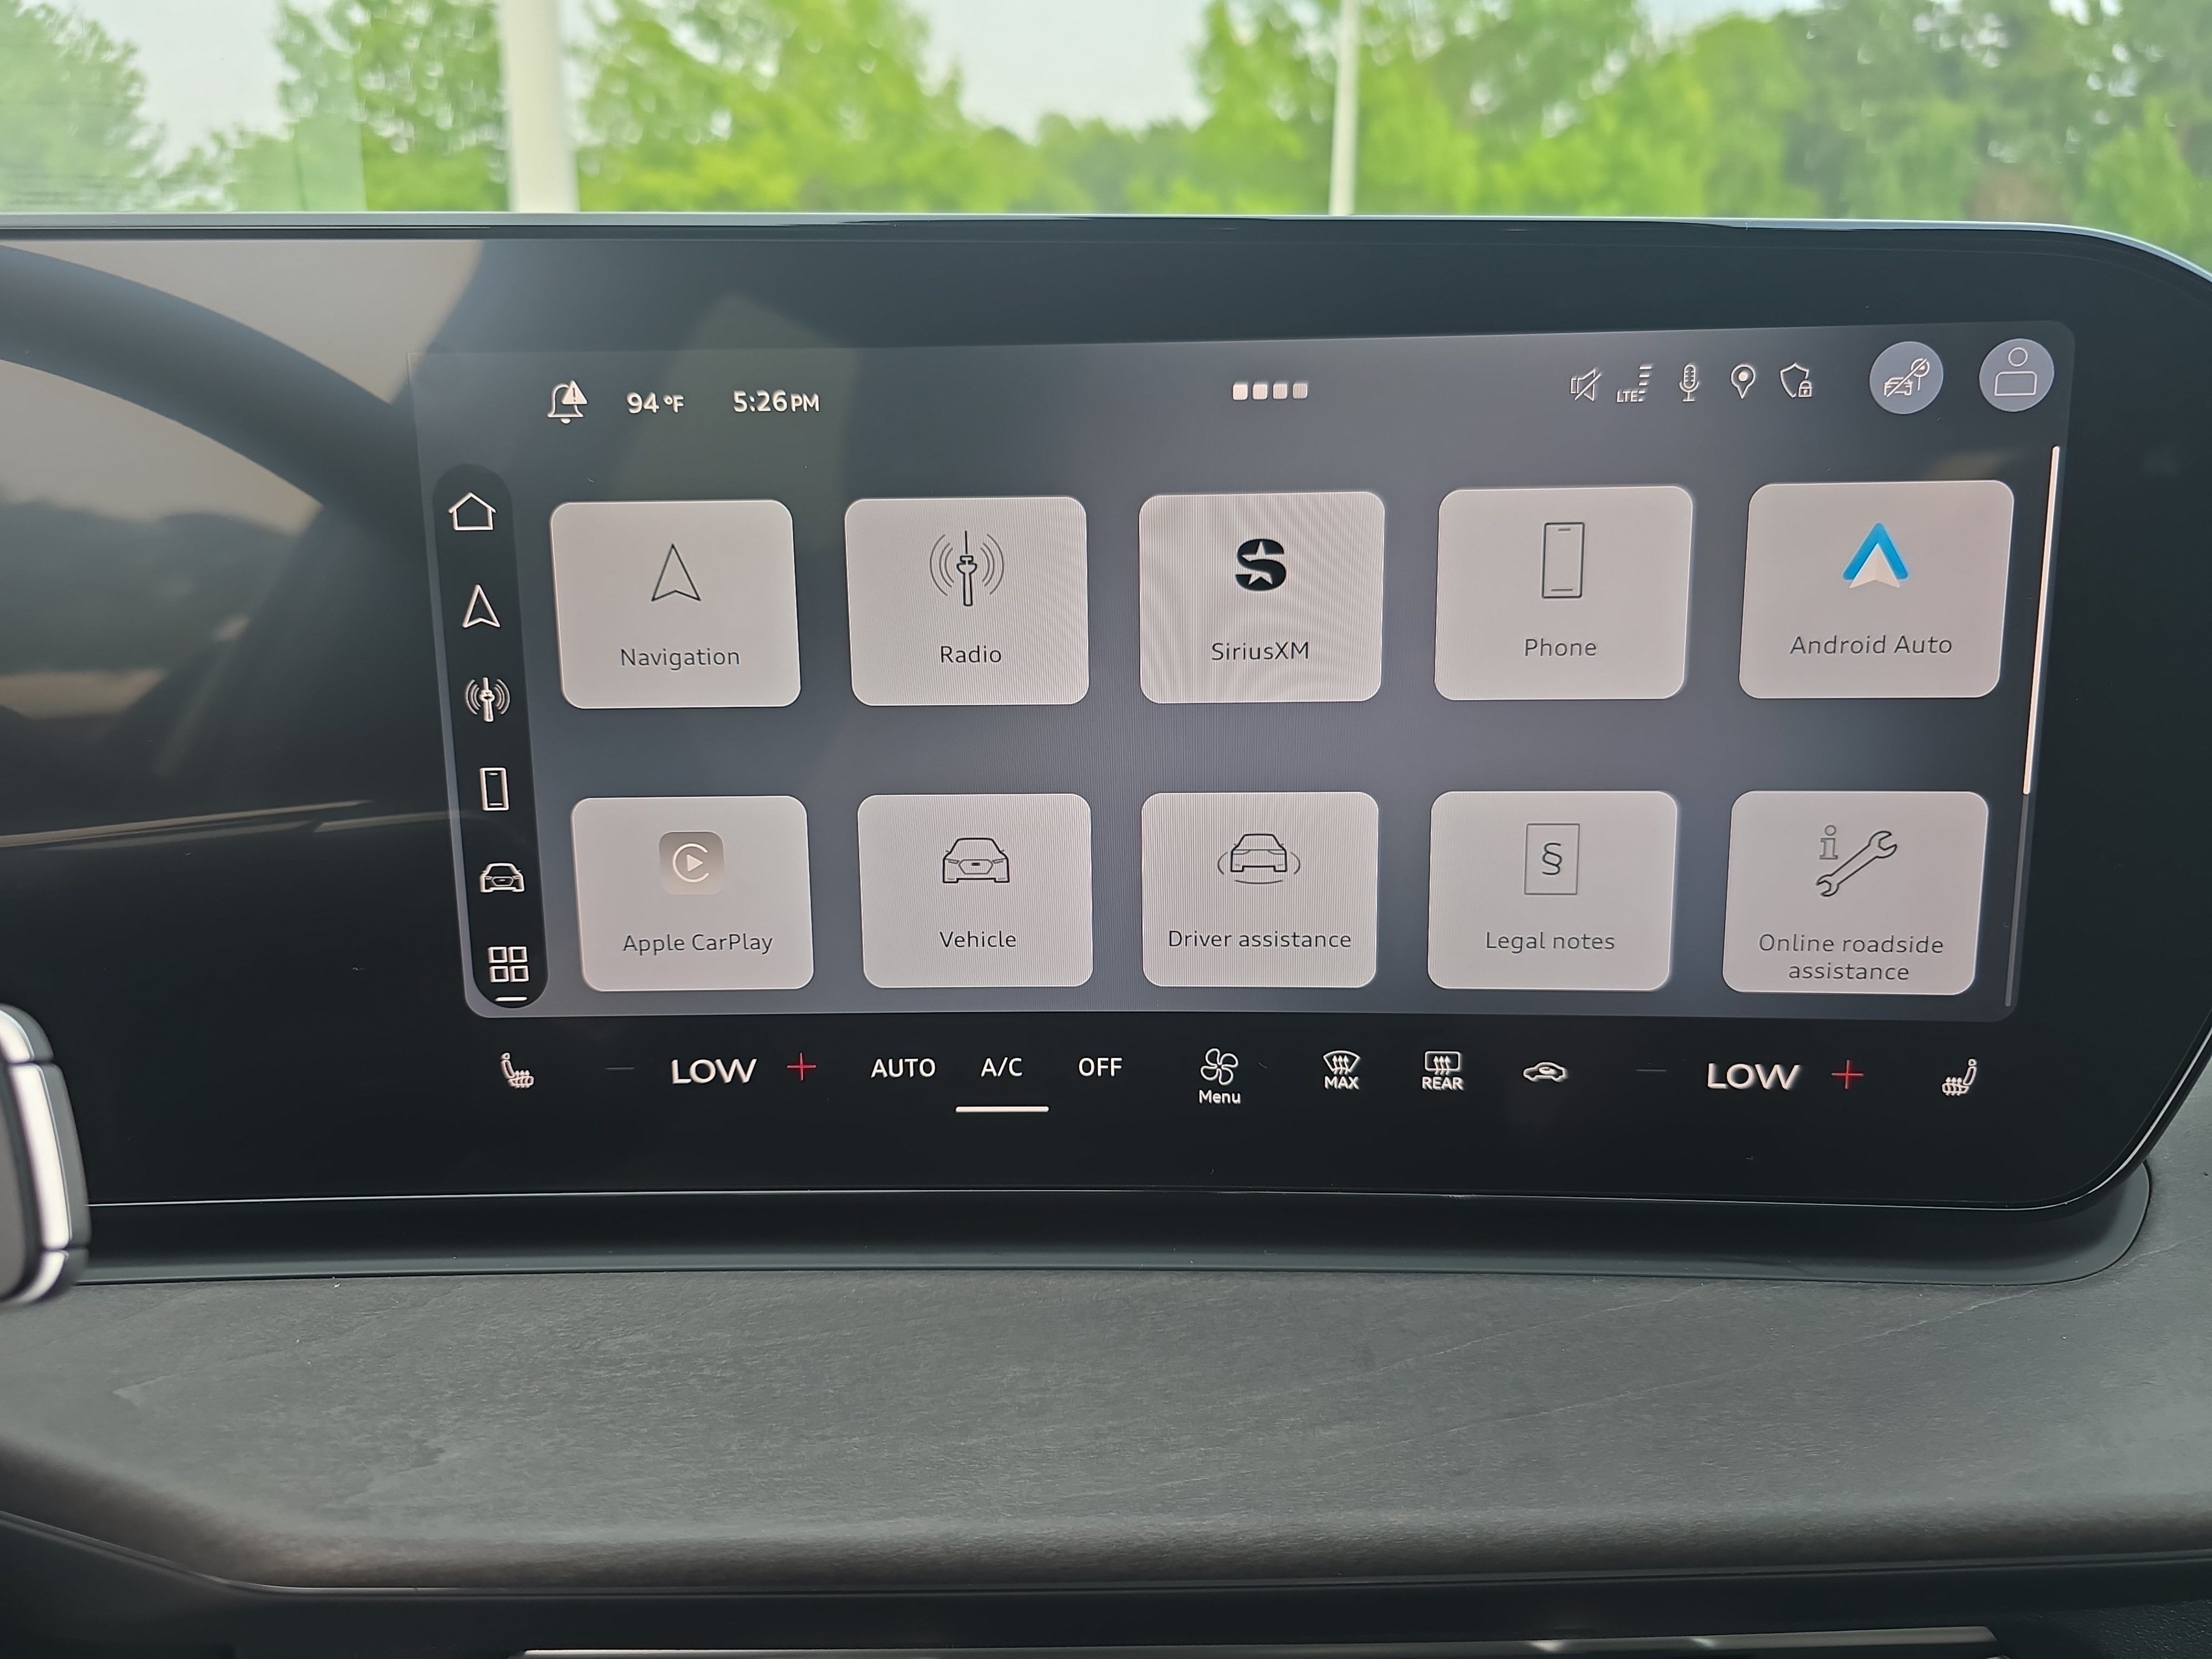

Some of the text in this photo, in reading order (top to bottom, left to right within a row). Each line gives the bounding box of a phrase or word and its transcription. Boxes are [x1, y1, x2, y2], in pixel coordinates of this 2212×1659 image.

[1617, 390, 1638, 402] LTE
[941, 645, 1002, 663] Radio
[1212, 641, 1309, 661] SiriusXM
[1525, 638, 1597, 657] Phone
[1790, 634, 1952, 654] Android Auto
[621, 648, 740, 671] Navigation
[1542, 842, 1562, 876] §
[623, 933, 773, 956] Apple CarPlay
[939, 930, 1016, 948] Vehicle
[1169, 930, 1351, 948] Driver assistance
[1486, 931, 1615, 954] Legal notes
[1759, 934, 1944, 954] Online roadside
[1789, 963, 1909, 980] assistance
[672, 1058, 757, 1084] LOW
[871, 1058, 936, 1078] AUTO
[981, 1057, 1023, 1077] A/C
[1078, 1057, 1122, 1077] OFF
[1707, 1063, 1800, 1090] LOW
[1324, 1076, 1359, 1090] MAX
[1422, 1076, 1463, 1090] REAR
[1199, 1089, 1241, 1104] Menu
